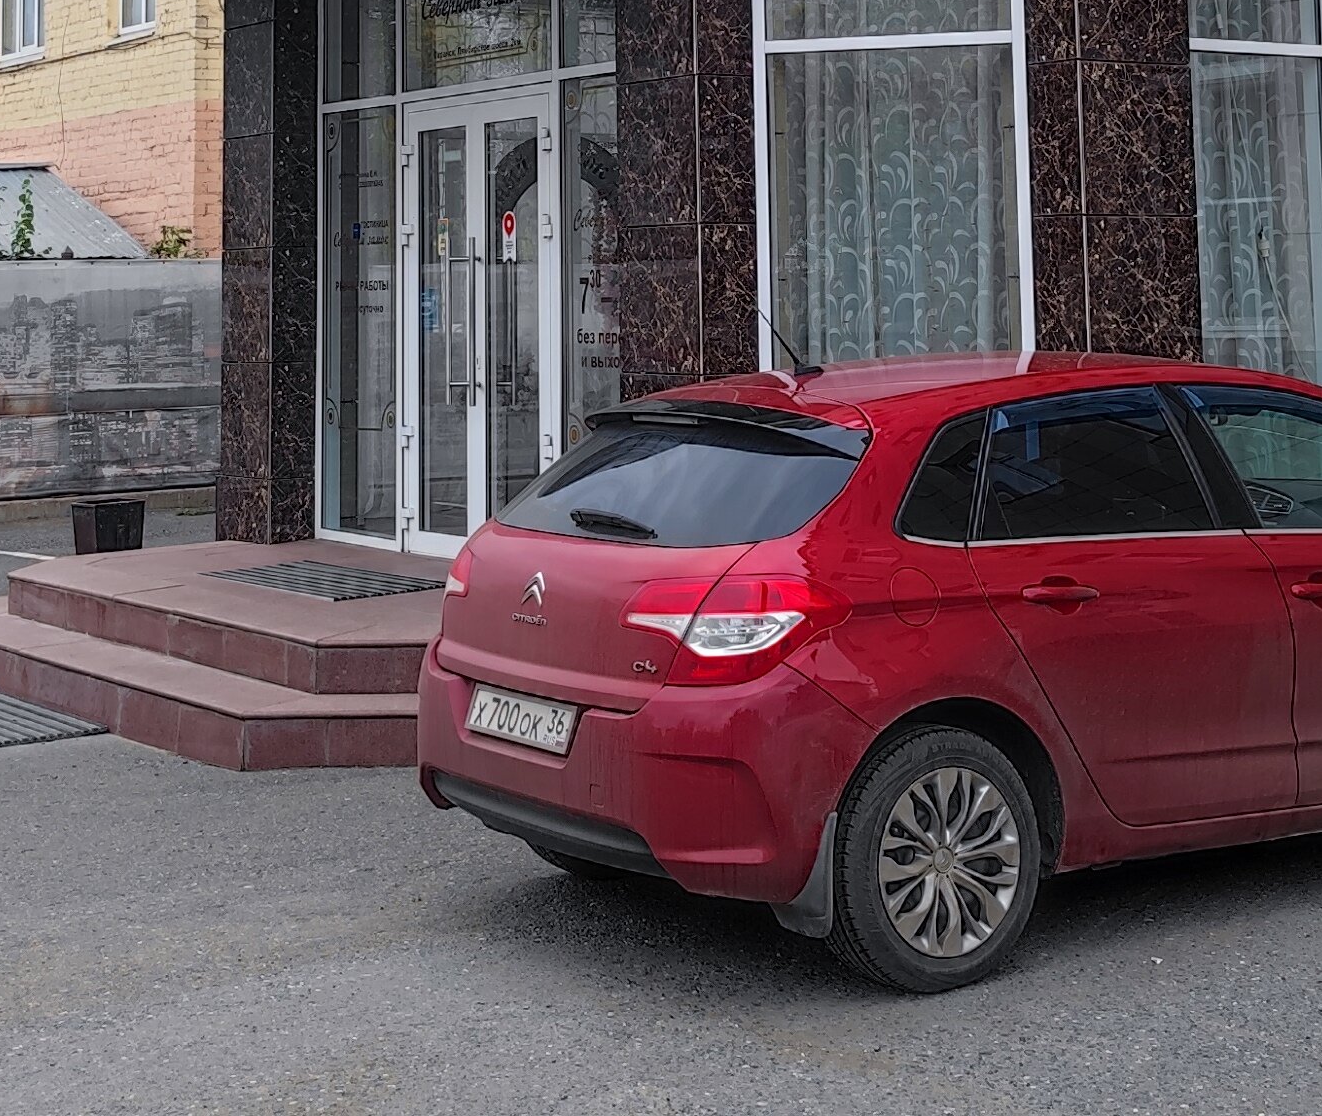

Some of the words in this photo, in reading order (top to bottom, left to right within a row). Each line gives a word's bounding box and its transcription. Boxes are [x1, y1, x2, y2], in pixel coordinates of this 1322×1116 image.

[360, 280, 389, 292] РАБОТЫ
[577, 328, 595, 345] без
[581, 356, 587, 368] и
[632, 660, 658, 674] C4
[546, 708, 565, 735] 36
[542, 734, 557, 746] RUS
